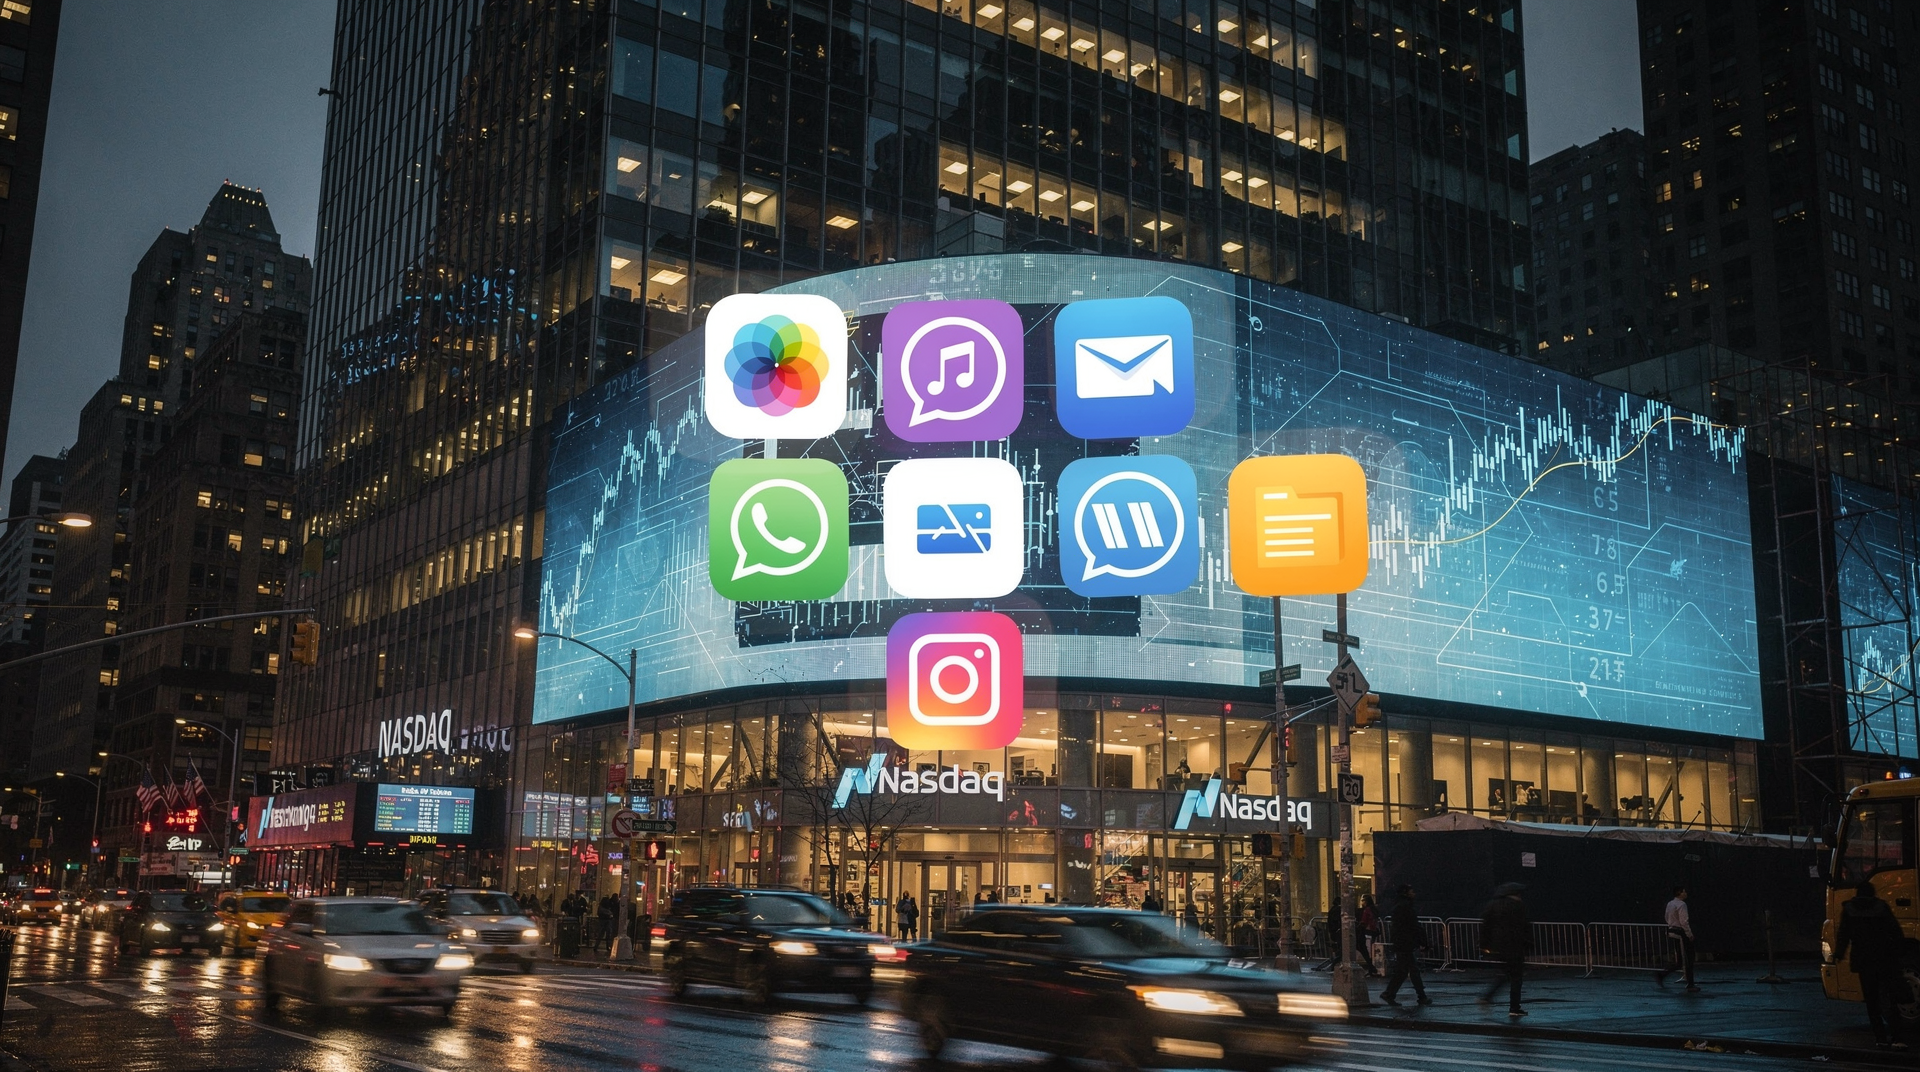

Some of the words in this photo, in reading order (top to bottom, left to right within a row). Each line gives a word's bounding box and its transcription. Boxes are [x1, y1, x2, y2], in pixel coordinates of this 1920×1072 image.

[1593, 486, 1618, 512] 65
[378, 709, 452, 759] NASDAQ
[878, 764, 1004, 802] Nasdaq
[1345, 782, 1359, 798] 20
[1220, 792, 1312, 830] Nasdaq
